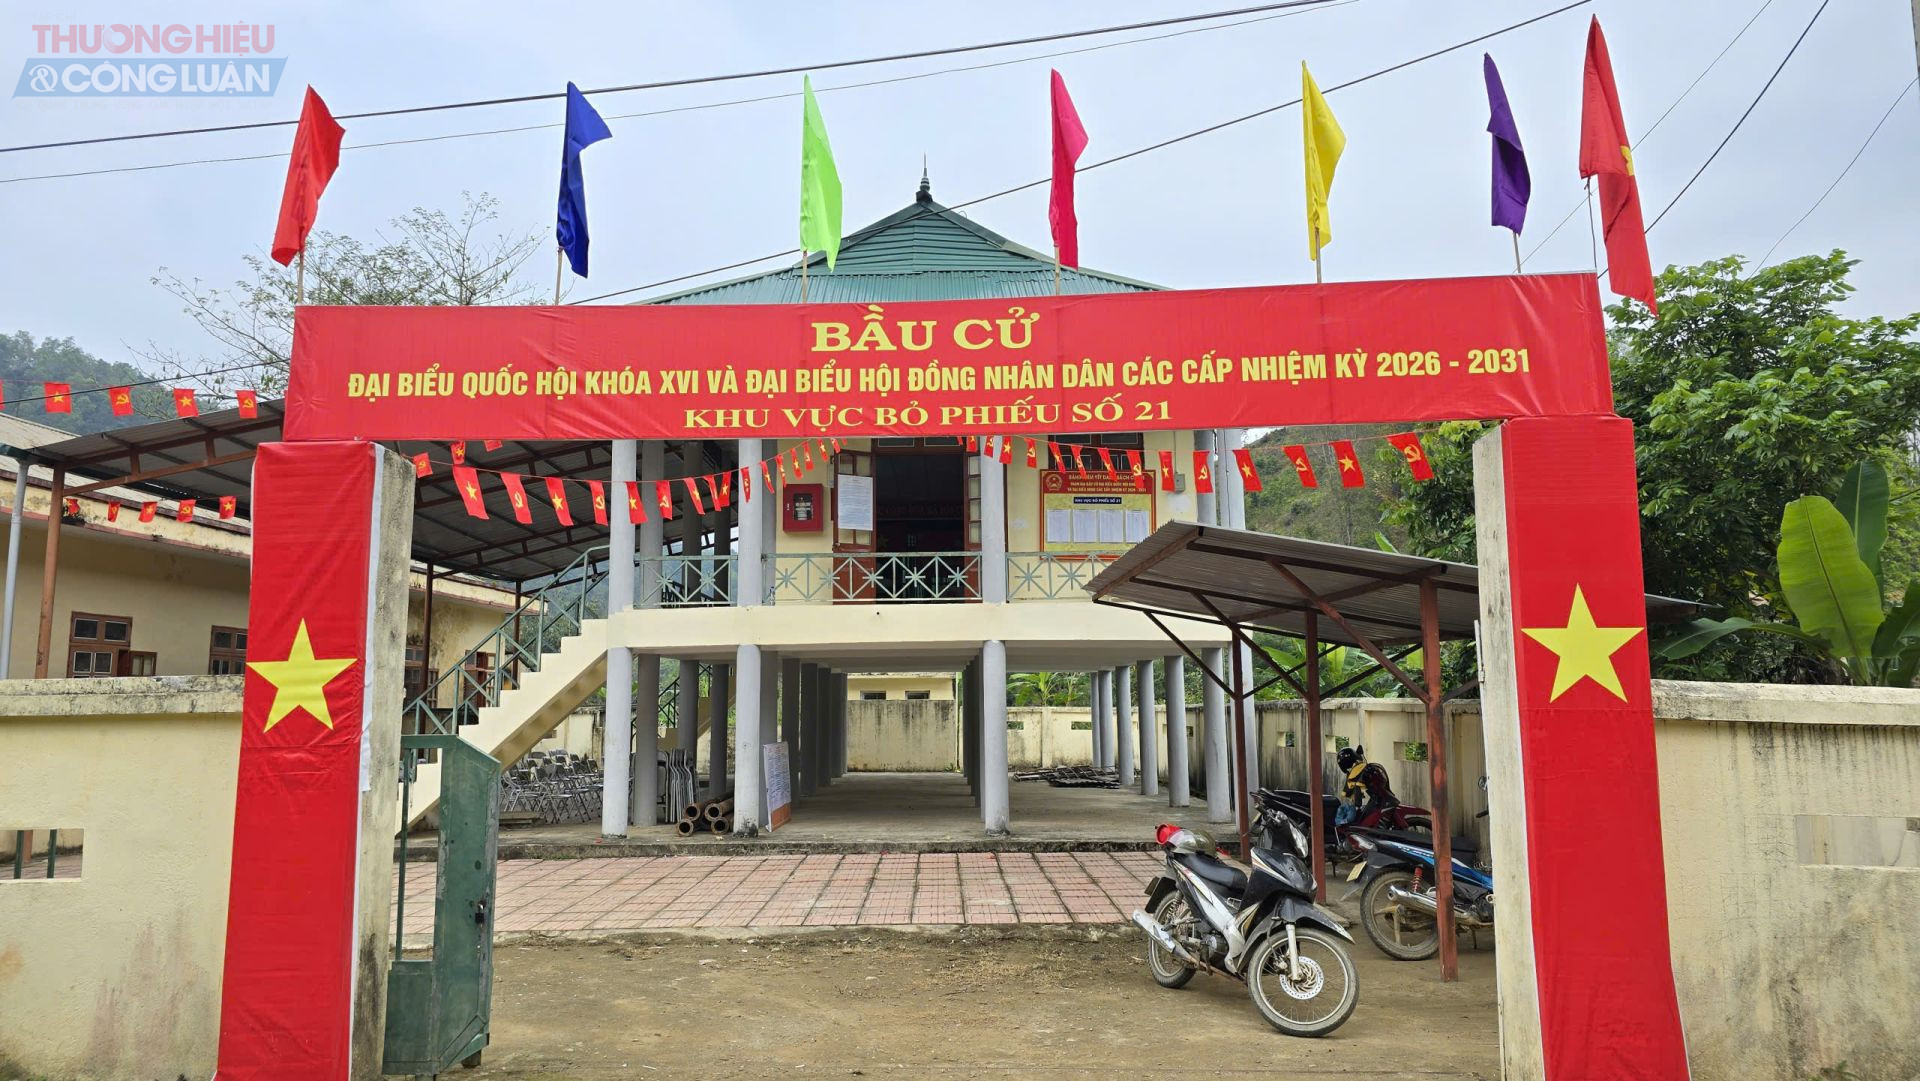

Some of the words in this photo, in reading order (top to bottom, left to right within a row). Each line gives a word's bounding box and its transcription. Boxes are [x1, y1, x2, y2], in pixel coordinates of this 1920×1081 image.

[811, 304, 937, 351] BẦU
[953, 307, 1040, 349] CỬ
[348, 373, 390, 402] ĐẠI
[398, 363, 454, 396] BIỂU
[463, 364, 528, 398] QUỐC
[536, 367, 576, 400] HỘI
[585, 366, 651, 394] KHÓA
[659, 370, 698, 394] XVI
[707, 365, 738, 393] VÀ
[746, 369, 787, 398] ĐẠI
[796, 359, 851, 392] BIỂU
[860, 363, 900, 397] HỘI
[908, 360, 975, 391] ĐỒNG
[984, 360, 1053, 390] NHÂN
[1063, 358, 1114, 387] DÂN
[1123, 356, 1173, 386] CÁC
[1182, 350, 1232, 384] CẤP
[1242, 351, 1326, 385] NHIỆM
[1335, 348, 1367, 378] KỲ
[1377, 351, 1440, 376] 2026
[1468, 349, 1529, 373] 2031
[685, 409, 769, 428] KHU
[782, 405, 863, 432] VỰC
[876, 400, 928, 425] BỎ
[940, 395, 1060, 425] PHIẾU
[1072, 393, 1123, 422] SỐ
[1135, 400, 1173, 421] 21
